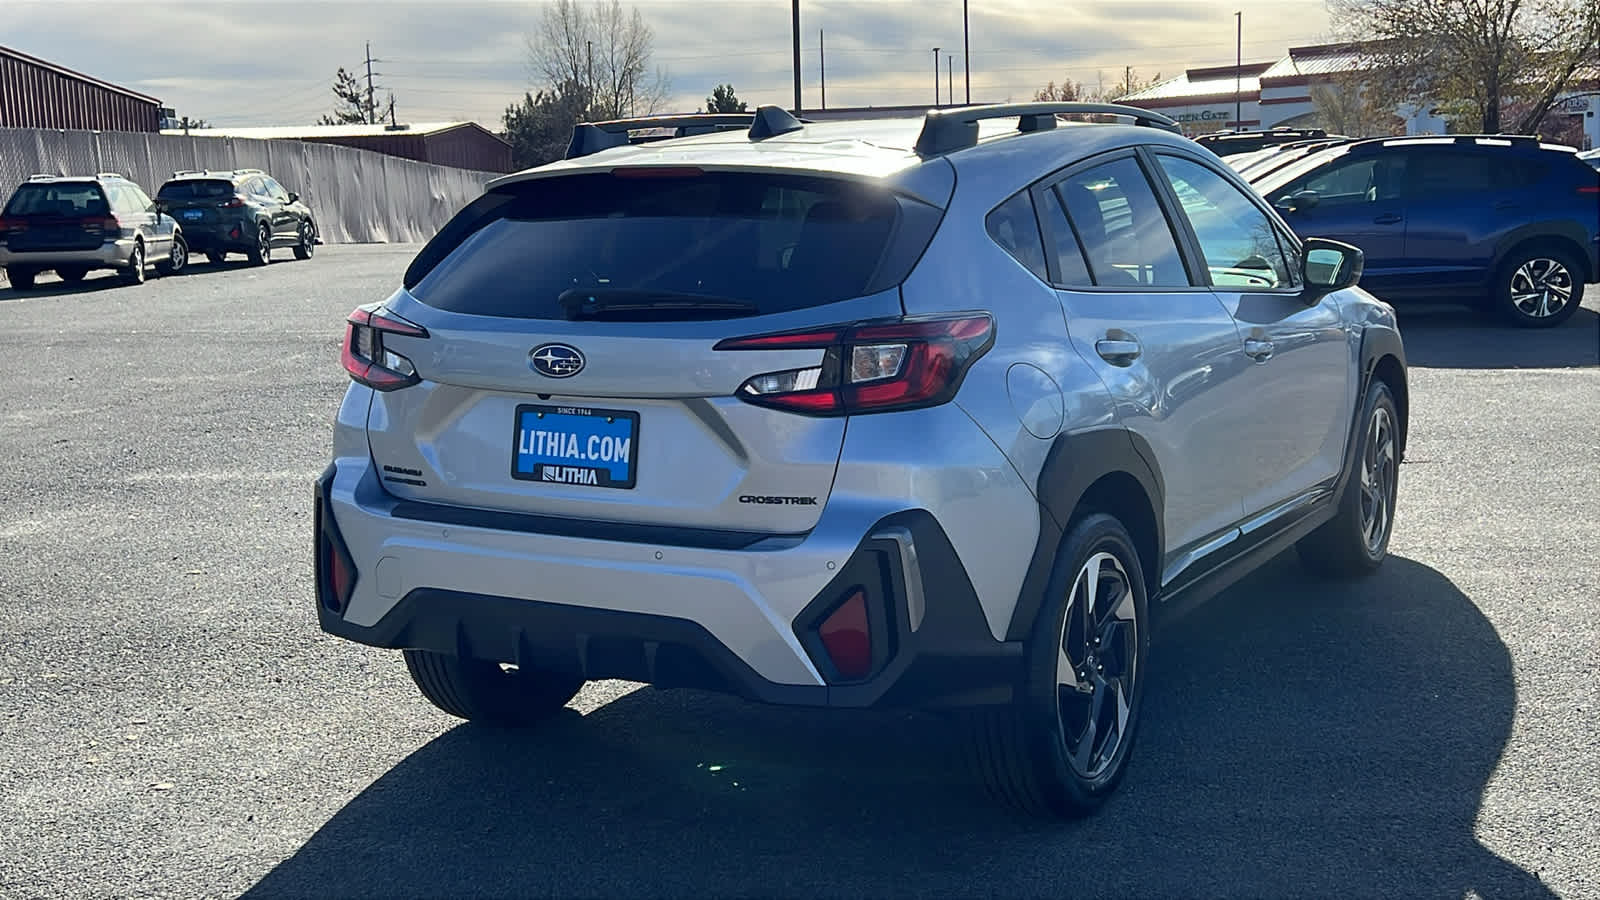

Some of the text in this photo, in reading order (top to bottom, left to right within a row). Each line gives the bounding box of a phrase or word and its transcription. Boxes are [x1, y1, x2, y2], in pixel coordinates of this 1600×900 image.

[1169, 112, 1200, 122] LDEN
[557, 407, 576, 415] SINCE
[519, 429, 631, 464] LITHIA.COM
[555, 465, 598, 485] LITHIA
[738, 495, 817, 505] CROSSTREK
